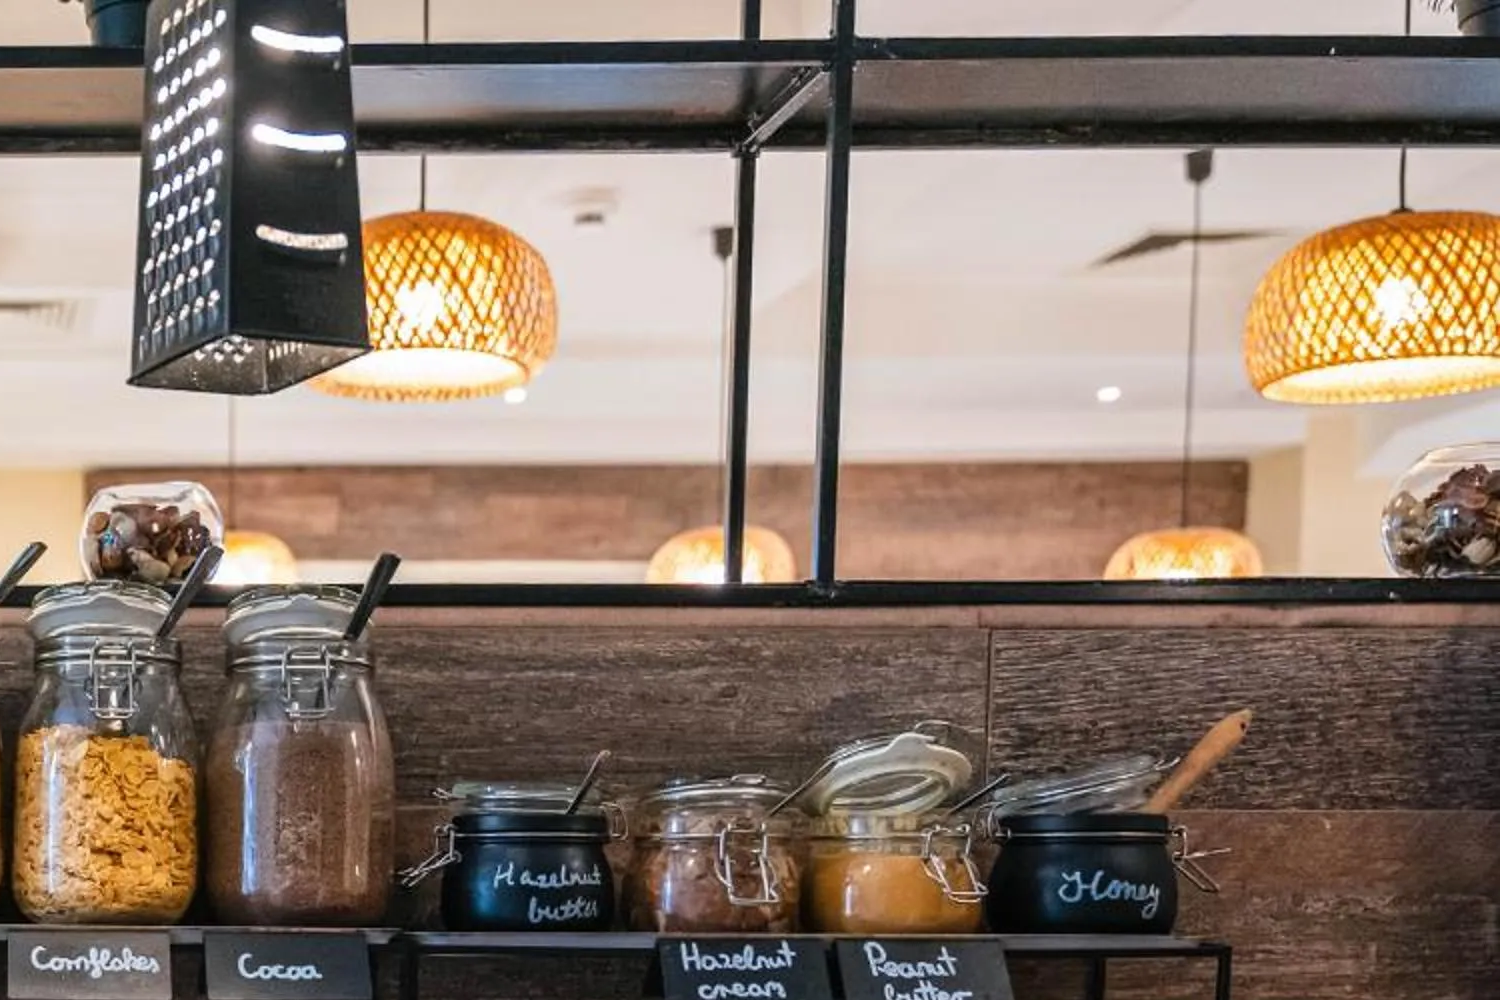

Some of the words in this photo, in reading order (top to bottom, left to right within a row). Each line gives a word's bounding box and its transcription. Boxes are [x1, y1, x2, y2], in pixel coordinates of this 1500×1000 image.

[493, 862, 601, 889] Hazelnut
[1058, 870, 1160, 919] Honey
[31, 946, 161, 979] Cornflakes
[238, 953, 323, 980] Cocoa
[680, 940, 796, 971] Hazelnut
[864, 941, 957, 977] Peanut
[698, 981, 787, 1000] cream
